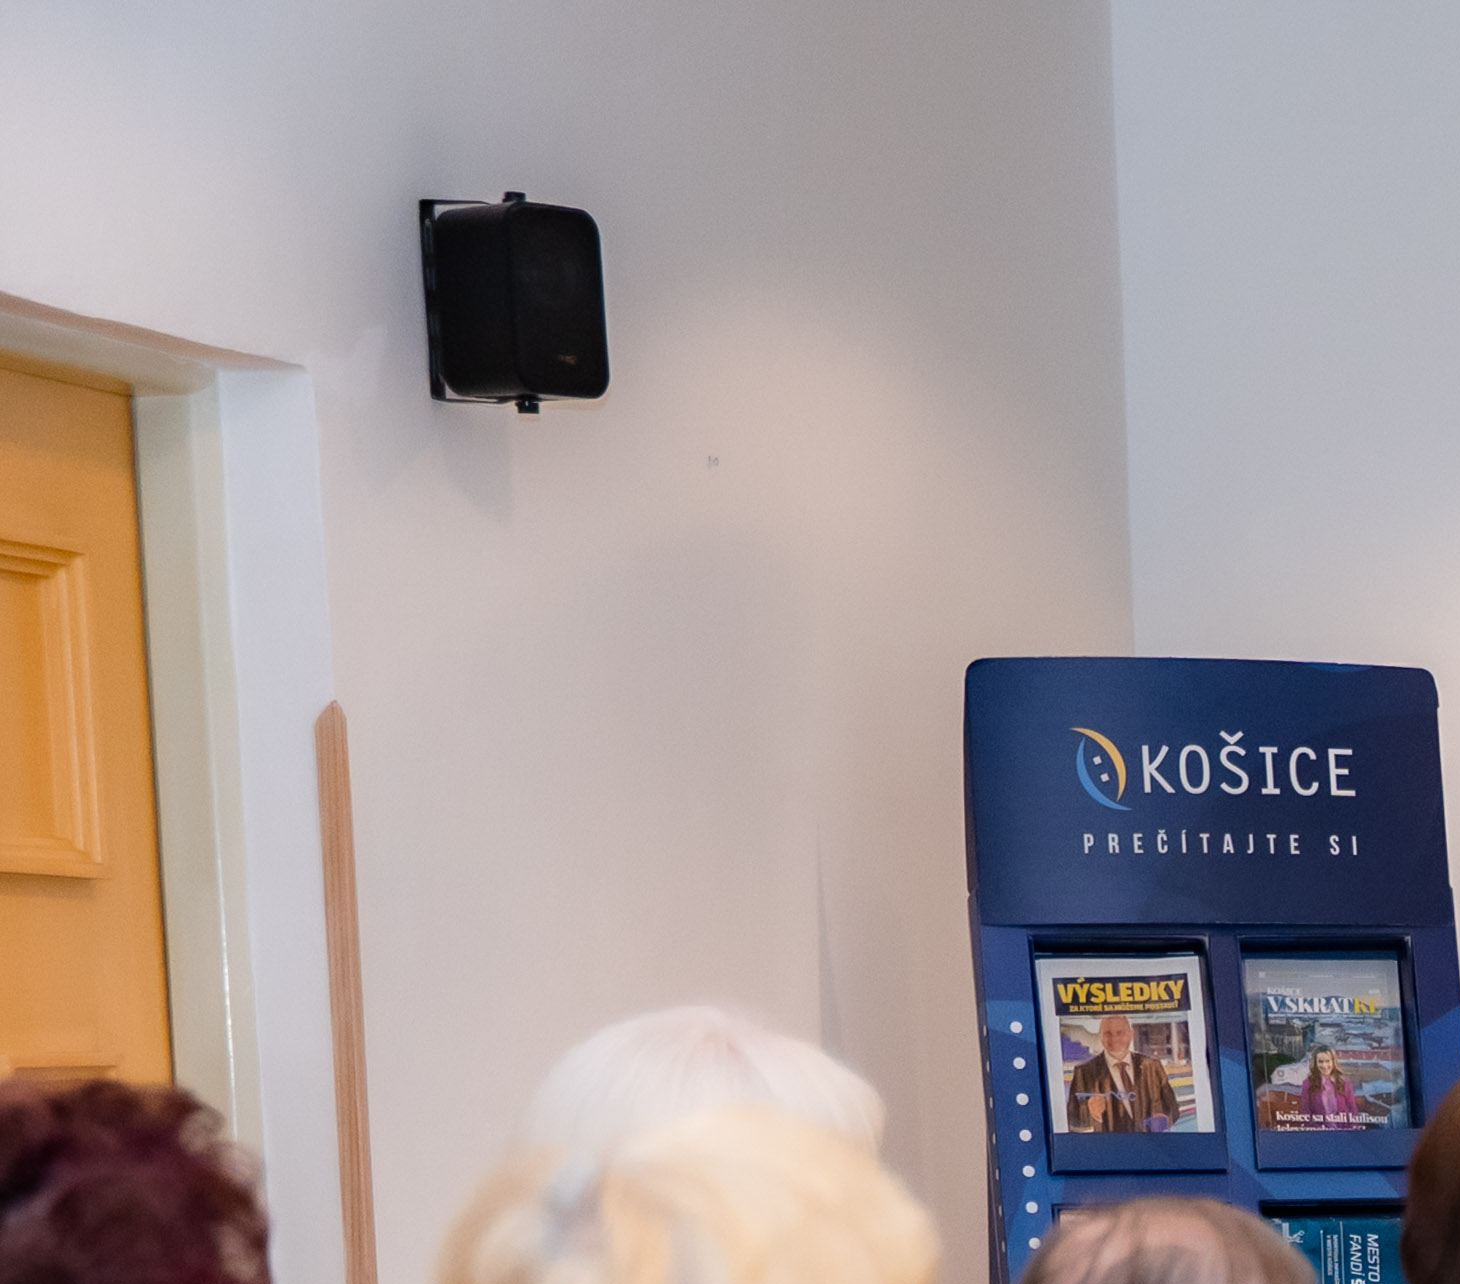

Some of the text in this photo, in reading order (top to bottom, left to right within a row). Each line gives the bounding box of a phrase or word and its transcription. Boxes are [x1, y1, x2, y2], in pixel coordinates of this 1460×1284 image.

[1142, 730, 1357, 797] KOŠICE
[1083, 829, 1358, 856] PREČÍTAJTE SI
[1057, 976, 1185, 1004] VÝSLEDKY
[1275, 1111, 1310, 1122] Košice
[1349, 1234, 1366, 1277] FANDÍ
[1366, 1233, 1381, 1283] MESTO
